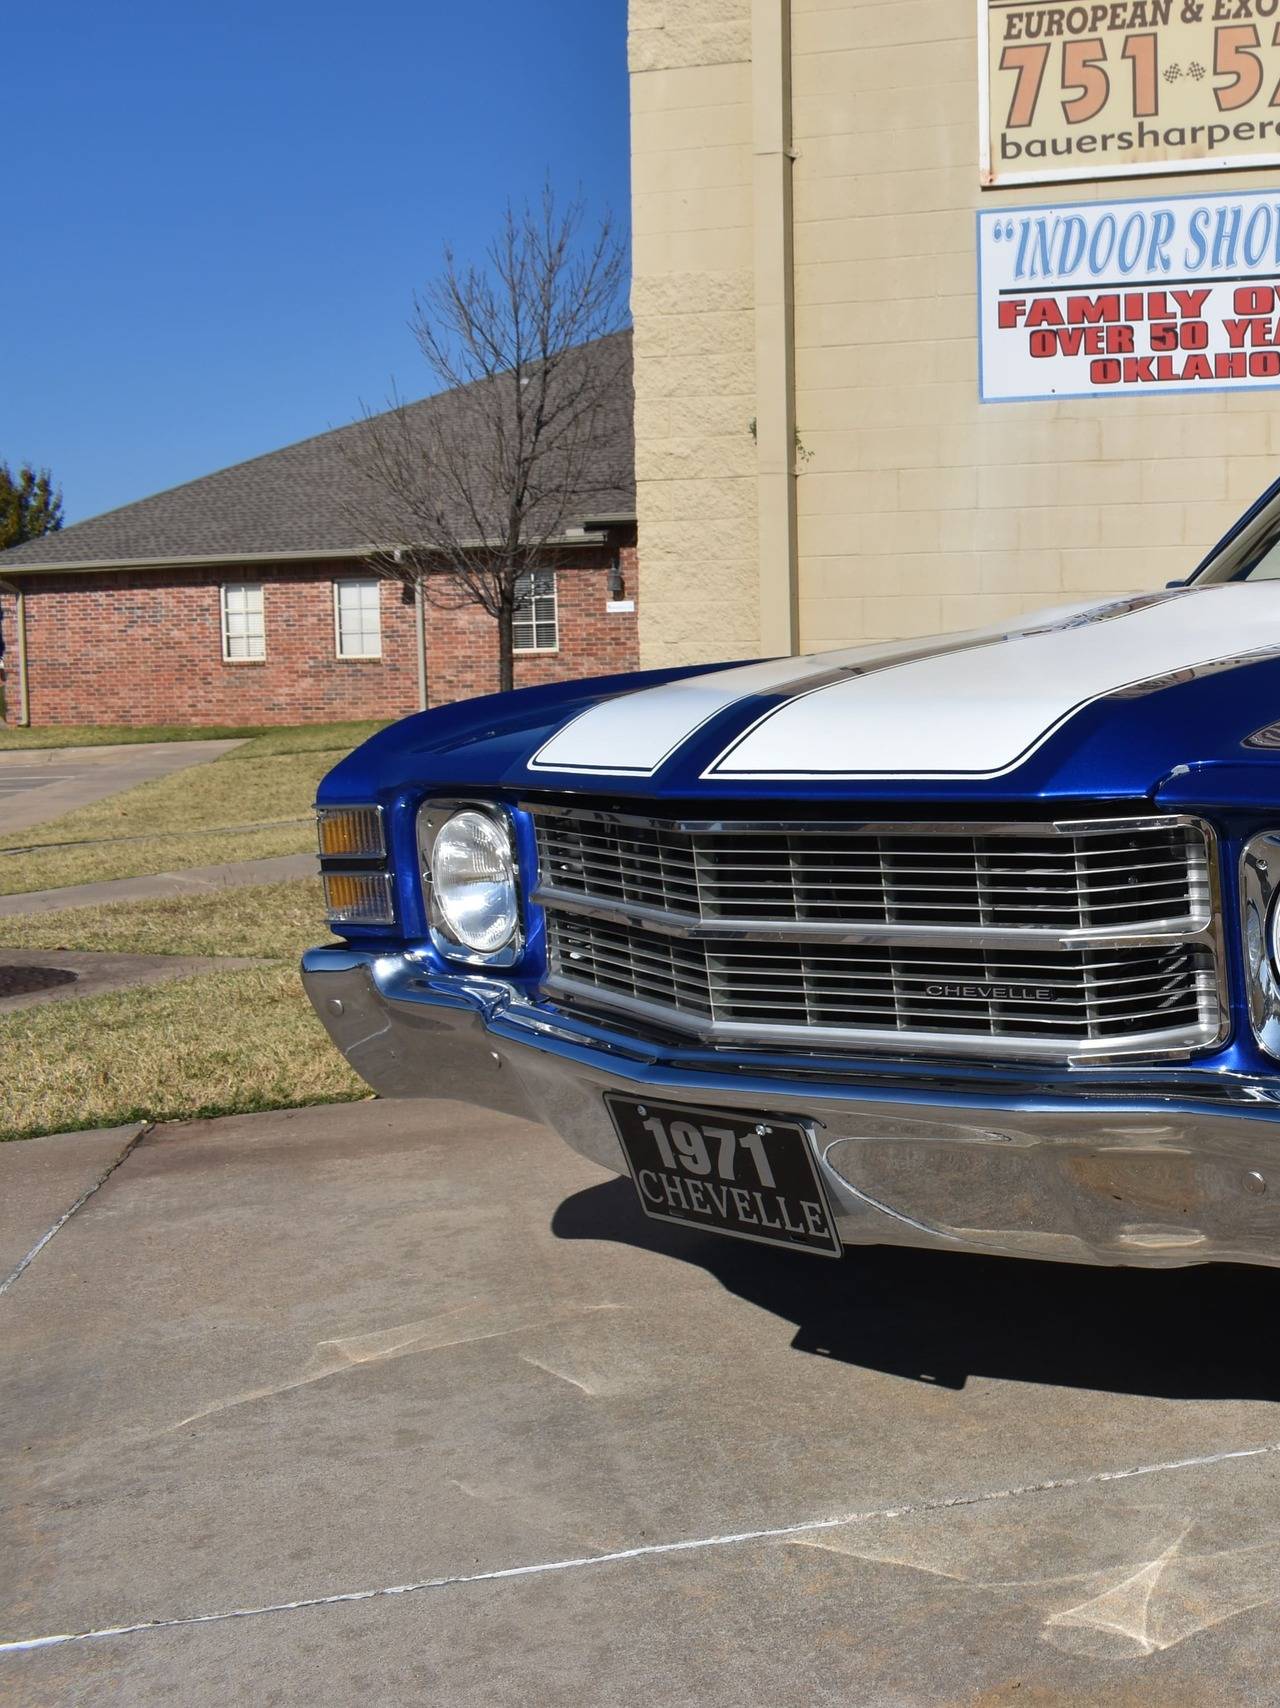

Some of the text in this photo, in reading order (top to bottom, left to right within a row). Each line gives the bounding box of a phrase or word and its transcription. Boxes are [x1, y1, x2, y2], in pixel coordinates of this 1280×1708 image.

[1003, 0, 1173, 40] EUROPEAN
[1180, 0, 1204, 24] &
[998, 33, 1160, 129] 751
[998, 288, 1213, 329] FAMILY
[1029, 324, 1135, 359] OVER
[1149, 320, 1209, 353] 50
[925, 984, 1052, 1000] CHEVELLE
[642, 1117, 777, 1189] 1971
[638, 1168, 832, 1239] CHEVELLE
